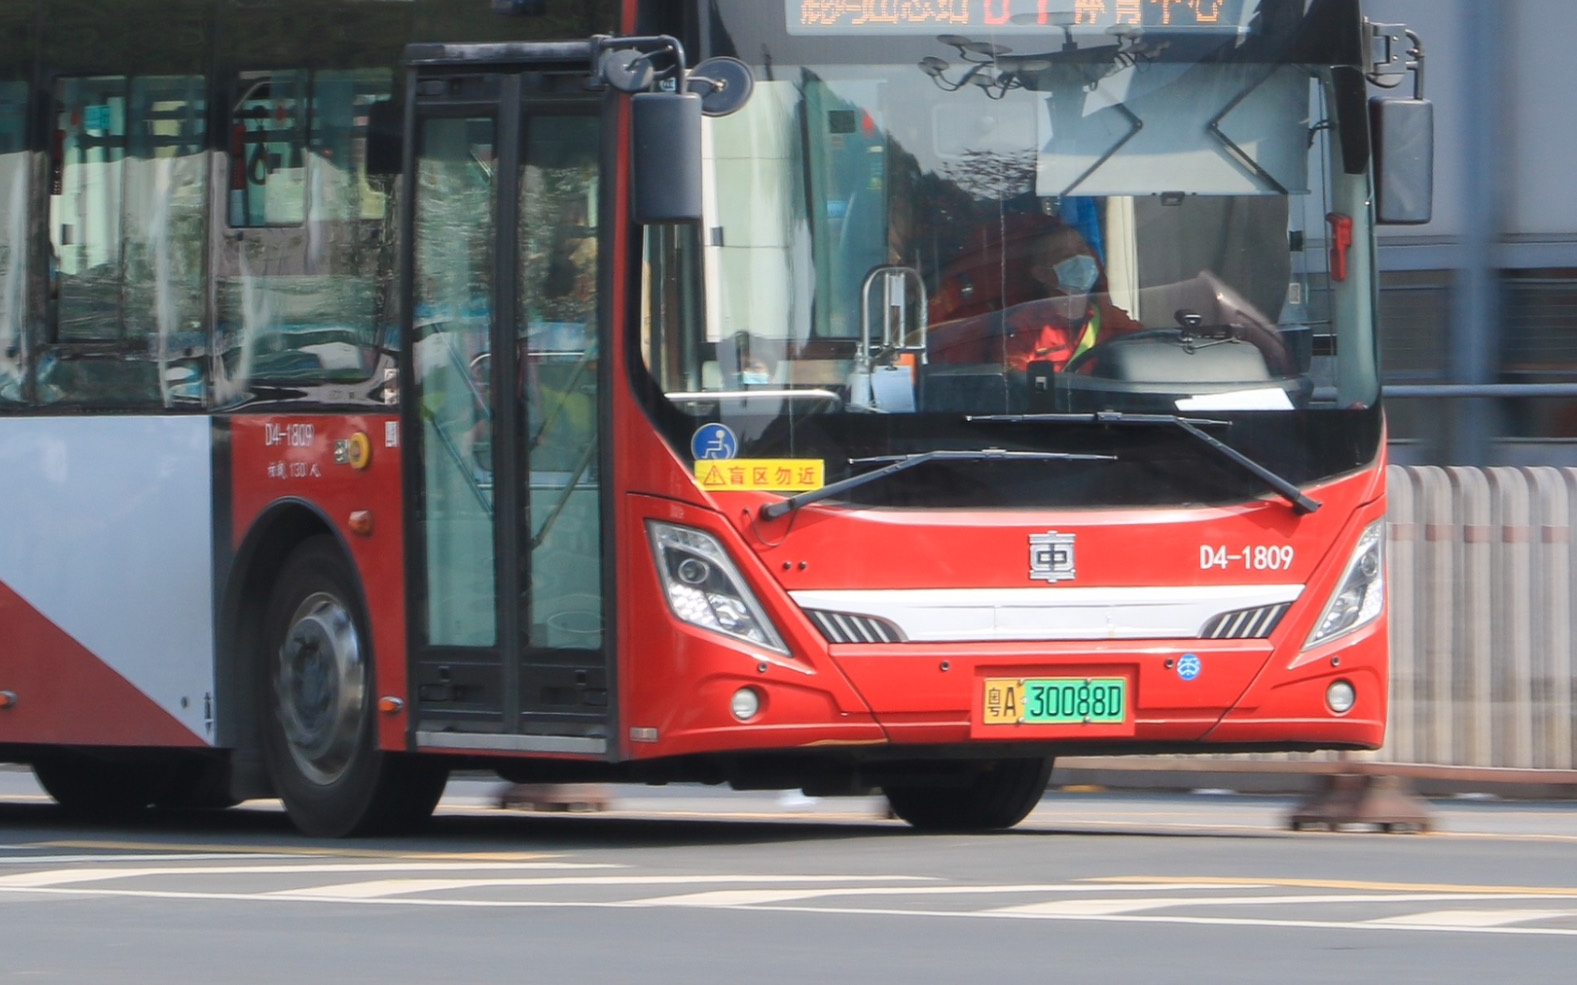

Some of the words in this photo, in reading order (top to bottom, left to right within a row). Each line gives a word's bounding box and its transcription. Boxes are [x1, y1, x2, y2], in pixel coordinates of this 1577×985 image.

[265, 423, 315, 447] D4-1809
[728, 466, 815, 486] 盲区勿近
[1199, 544, 1294, 570] D4-1809
[987, 686, 1017, 717] 粤A
[1030, 685, 1122, 717] 30088D
